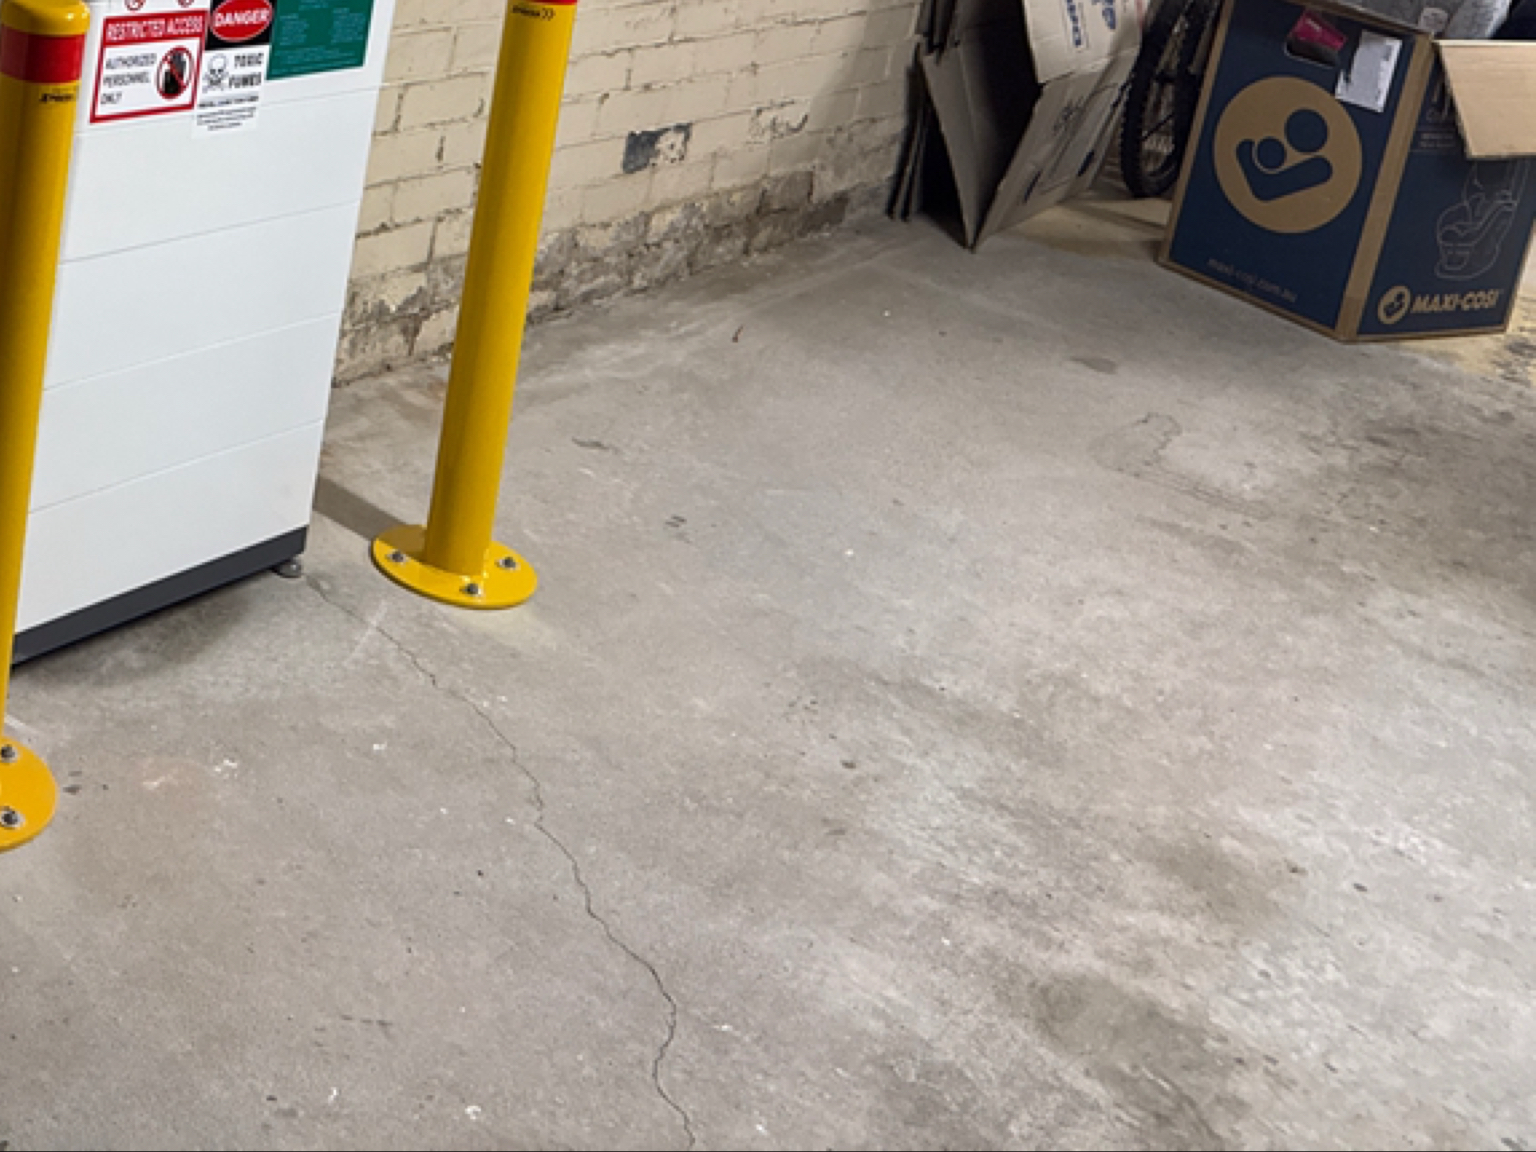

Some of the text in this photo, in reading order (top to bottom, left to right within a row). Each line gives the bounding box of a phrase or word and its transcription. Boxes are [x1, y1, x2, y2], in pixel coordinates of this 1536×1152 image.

[214, 8, 270, 27] DANGER
[107, 15, 203, 40] RESTRICTED ACCESS
[233, 52, 264, 67] TOXIC
[103, 72, 149, 88] PERSONNEL
[228, 72, 262, 89] FUMES
[100, 91, 122, 105] ONLY
[1410, 289, 1499, 314] MAXI-COSI
